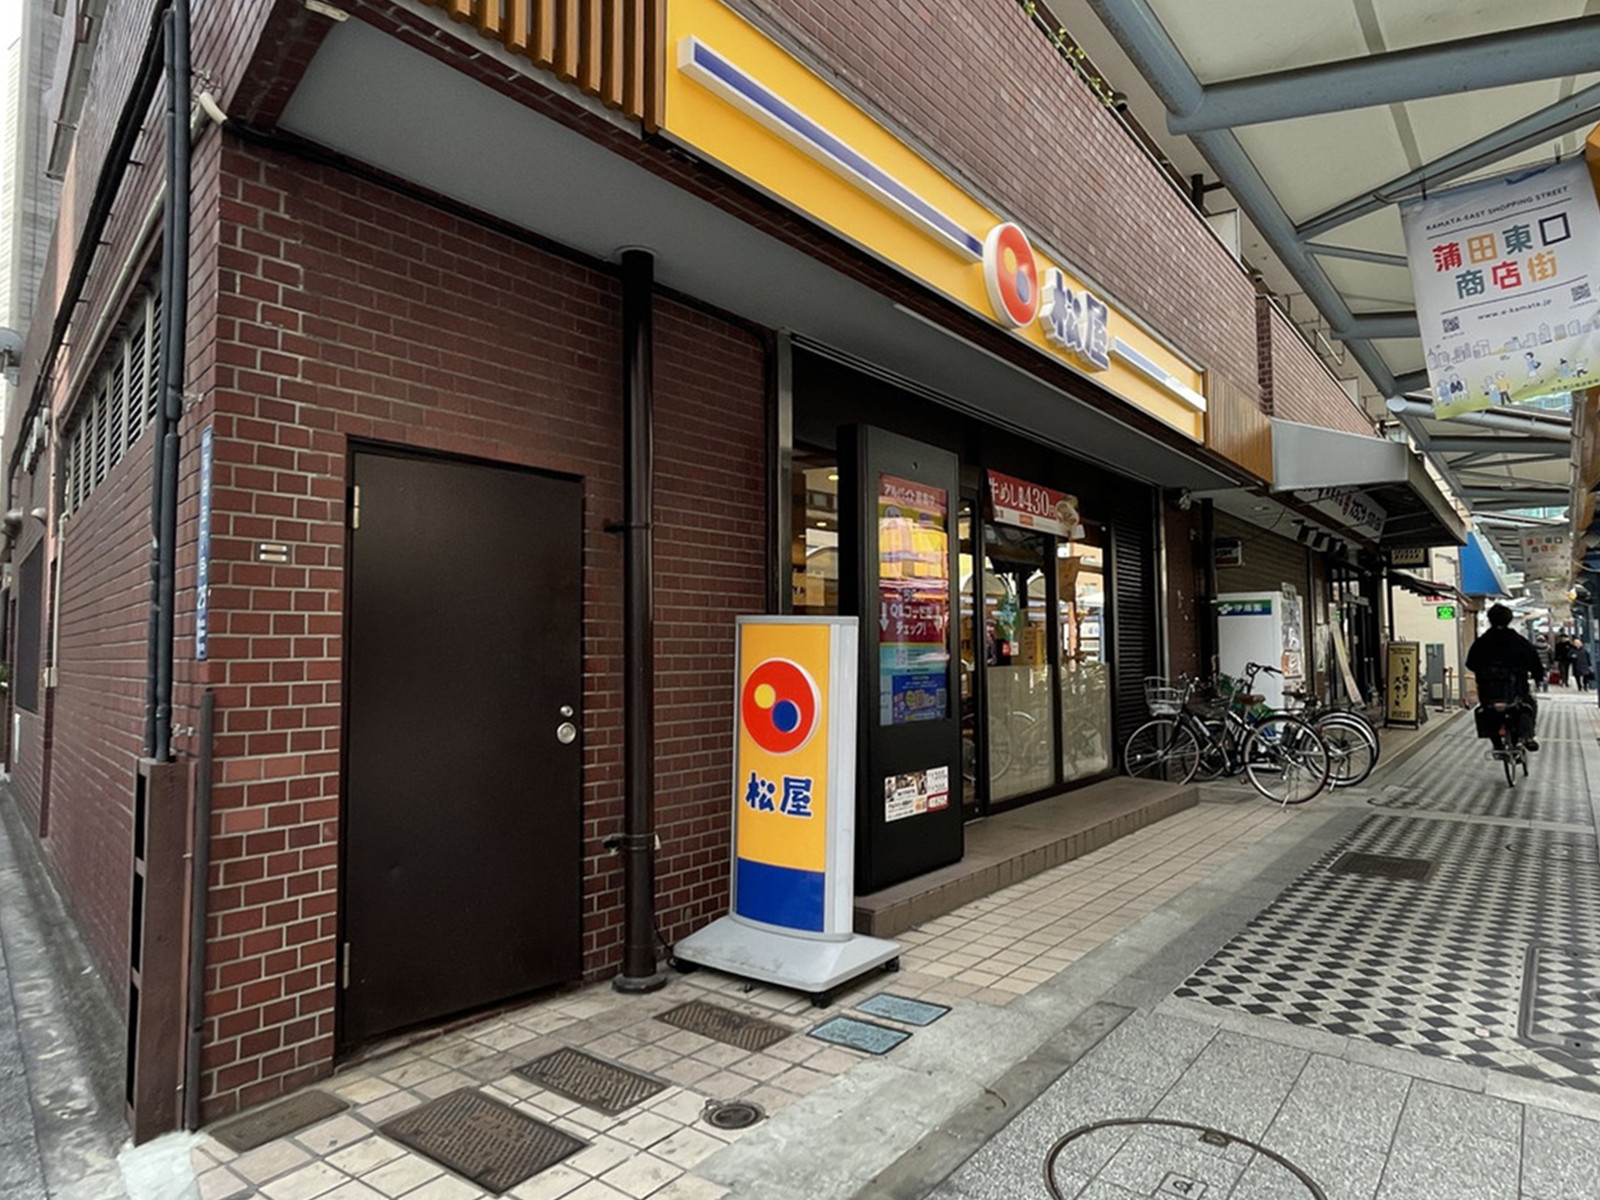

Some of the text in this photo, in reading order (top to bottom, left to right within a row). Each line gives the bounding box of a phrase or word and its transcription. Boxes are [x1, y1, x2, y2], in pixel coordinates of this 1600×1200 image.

[1426, 186, 1568, 231] KAMATA-EAST SHOPPING STREET
[1433, 212, 1571, 272] 蒲田東口
[1455, 250, 1558, 299] 商店街
[1044, 267, 1109, 370] 松屋
[745, 771, 813, 818] 松屋
